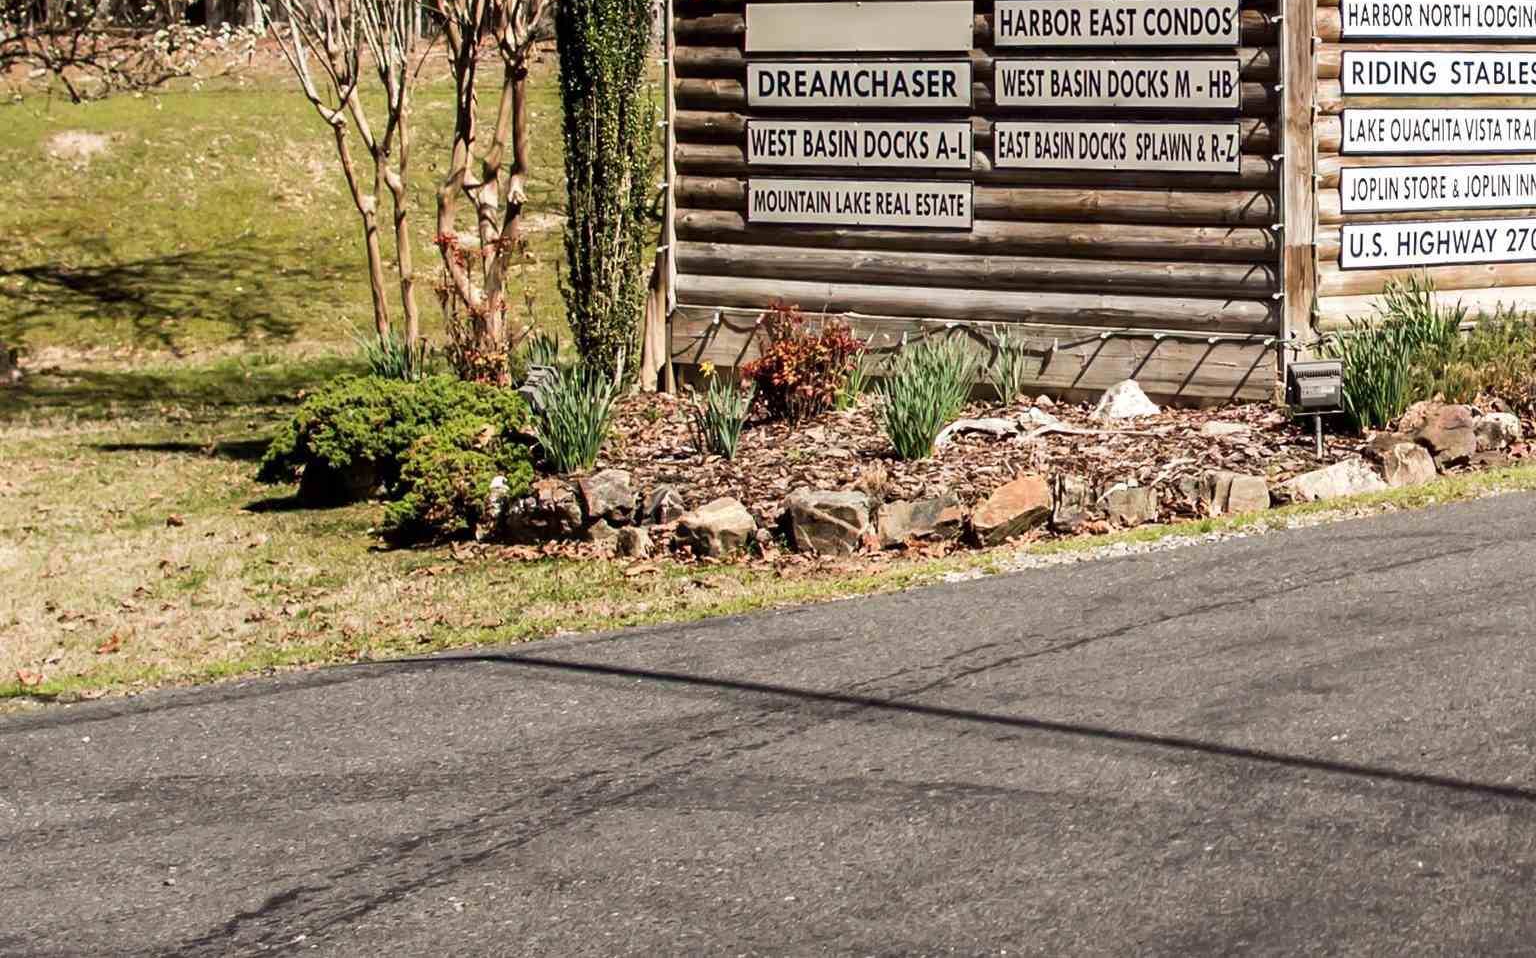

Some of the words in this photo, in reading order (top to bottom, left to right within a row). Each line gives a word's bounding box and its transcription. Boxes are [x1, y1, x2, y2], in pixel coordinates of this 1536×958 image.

[1001, 9, 1082, 37] HARBOR
[1090, 8, 1136, 36] EAST
[1144, 7, 1232, 36] CONDOS
[1349, 3, 1413, 27] HARBOR
[1420, 4, 1471, 27] NORTH
[759, 70, 957, 97] DREAMCHASER
[1002, 70, 1044, 97] WEST
[1051, 70, 1100, 97] BASIN
[1108, 70, 1168, 98] DOCKS
[1175, 70, 1190, 98] M
[1209, 70, 1233, 98] HB
[1352, 61, 1437, 85] RIDING
[751, 129, 796, 156] WEST
[804, 130, 857, 158] BASIN
[864, 131, 928, 159] DOCKS
[936, 132, 966, 160] A-L
[1349, 119, 1385, 141] LAKE
[1391, 119, 1461, 142] OUACHITA
[1465, 119, 1501, 142] VISTA
[999, 132, 1030, 159] EAST
[1035, 132, 1074, 160] BASIN
[1080, 132, 1126, 160] DOCKS
[1136, 133, 1192, 161] SPLAWN
[1197, 135, 1205, 161] &
[1211, 135, 1234, 163] R-Z
[1351, 176, 1398, 202] JOPLIN
[1404, 176, 1446, 200] STORE
[1453, 180, 1459, 198] &
[1465, 174, 1512, 198] JOPLIN
[754, 191, 830, 213] MOUNTAIN
[836, 192, 871, 214] LAKE
[876, 193, 911, 215] REAL
[916, 194, 964, 216] ESTATE
[1350, 233, 1387, 257] U.S.
[1398, 229, 1497, 256] HIGHWAY
